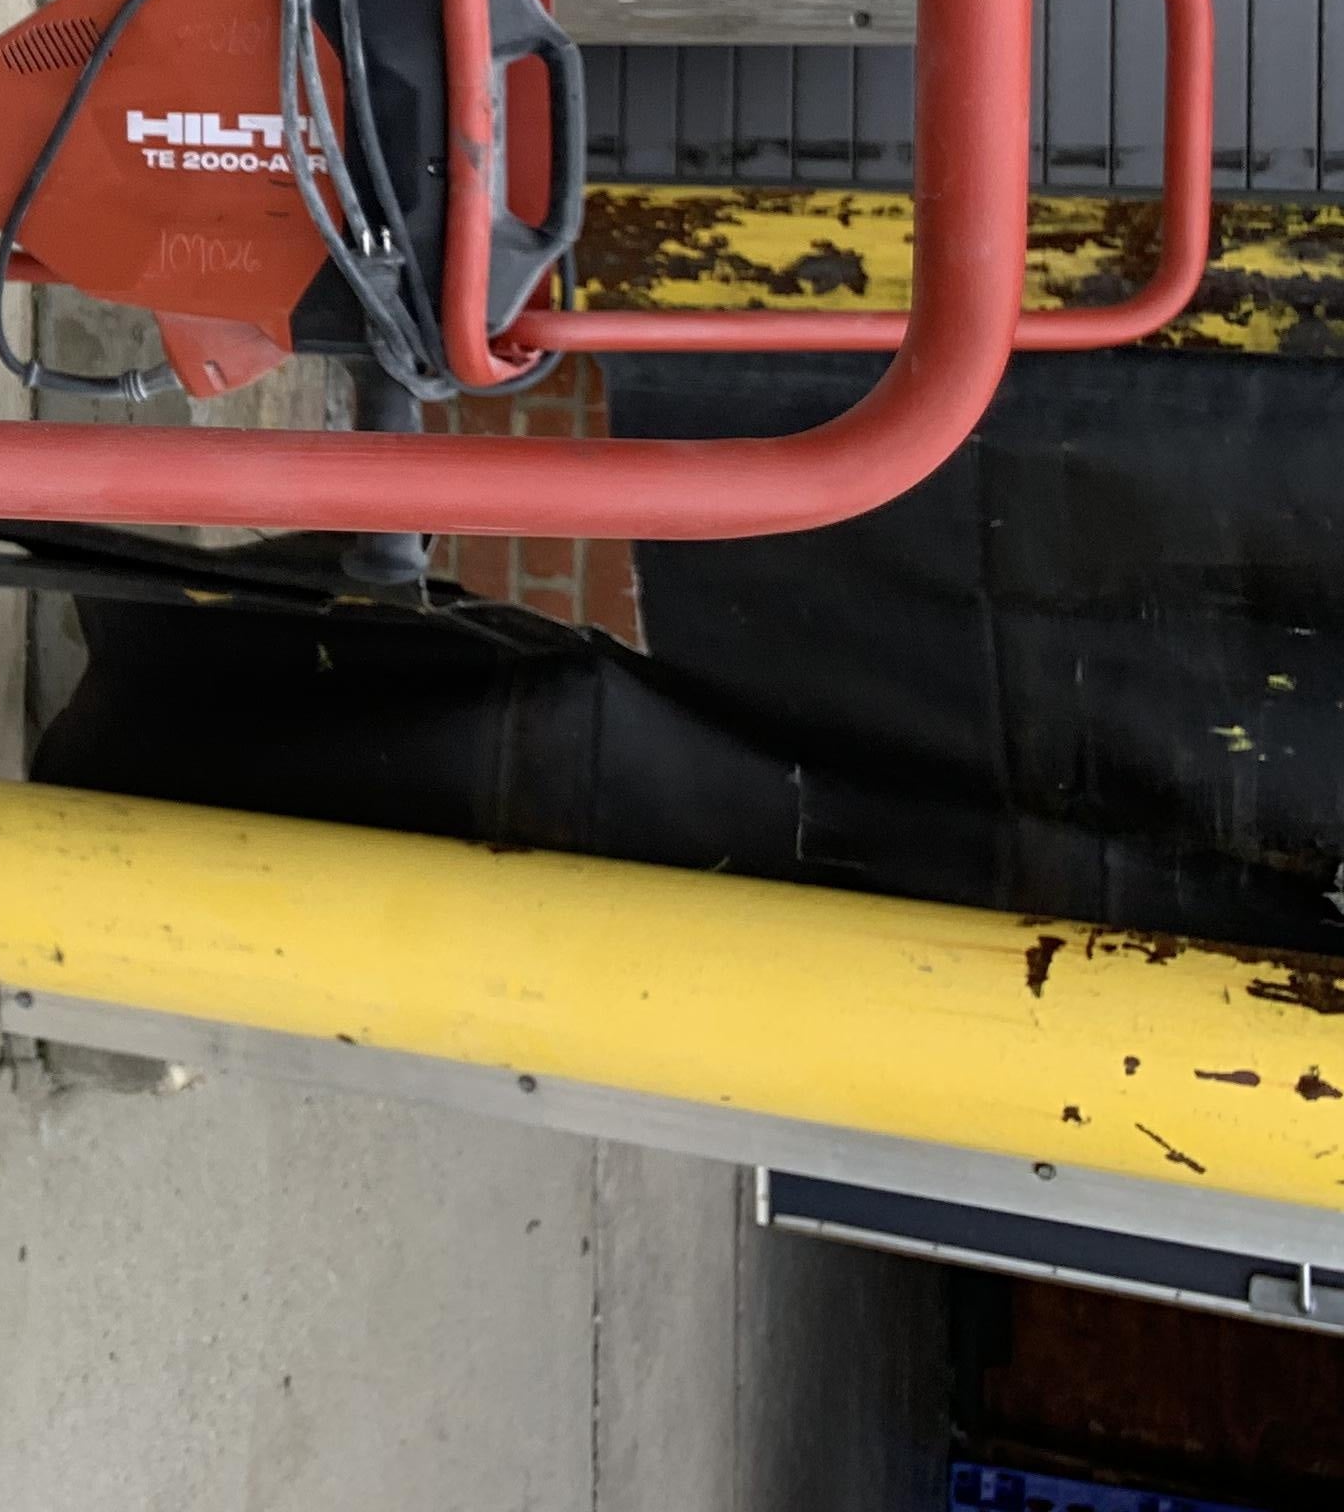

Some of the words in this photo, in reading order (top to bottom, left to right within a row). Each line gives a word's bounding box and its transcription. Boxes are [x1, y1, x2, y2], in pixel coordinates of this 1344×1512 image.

[126, 110, 324, 148] HILTI
[141, 148, 176, 169] TE
[182, 150, 330, 175] 2000-AR
